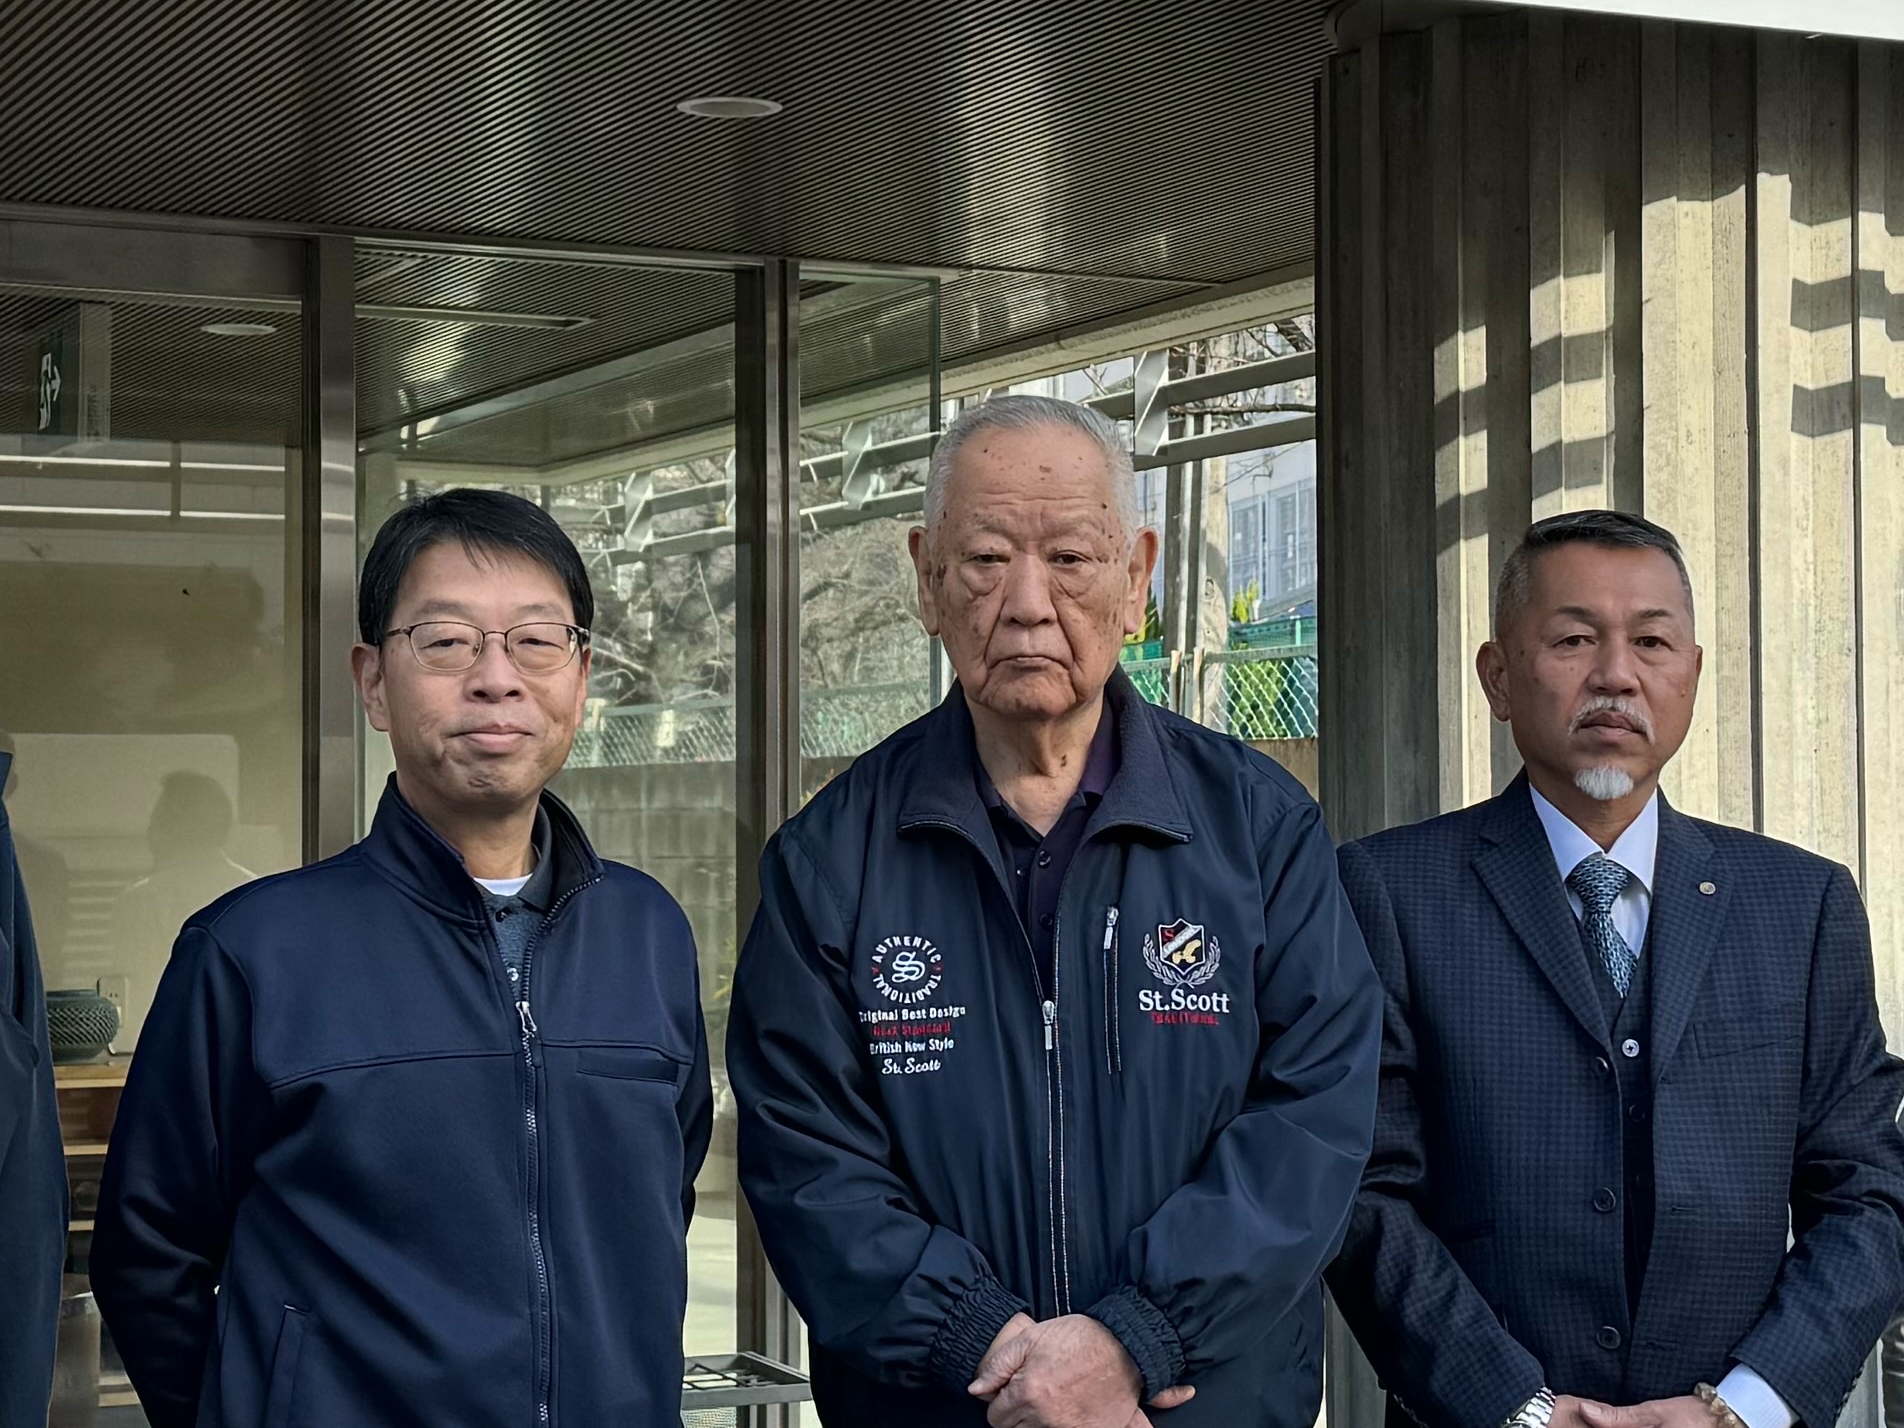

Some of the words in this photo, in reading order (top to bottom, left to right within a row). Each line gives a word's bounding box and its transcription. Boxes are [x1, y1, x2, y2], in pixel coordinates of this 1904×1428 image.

[871, 936, 943, 964] AUTHENTIC
[872, 974, 942, 1003] TRADITIONAL
[1138, 988, 1230, 1013] St.Scott
[901, 1008, 927, 1020] Best
[929, 1005, 966, 1018] Design
[928, 1037, 955, 1051] Style
